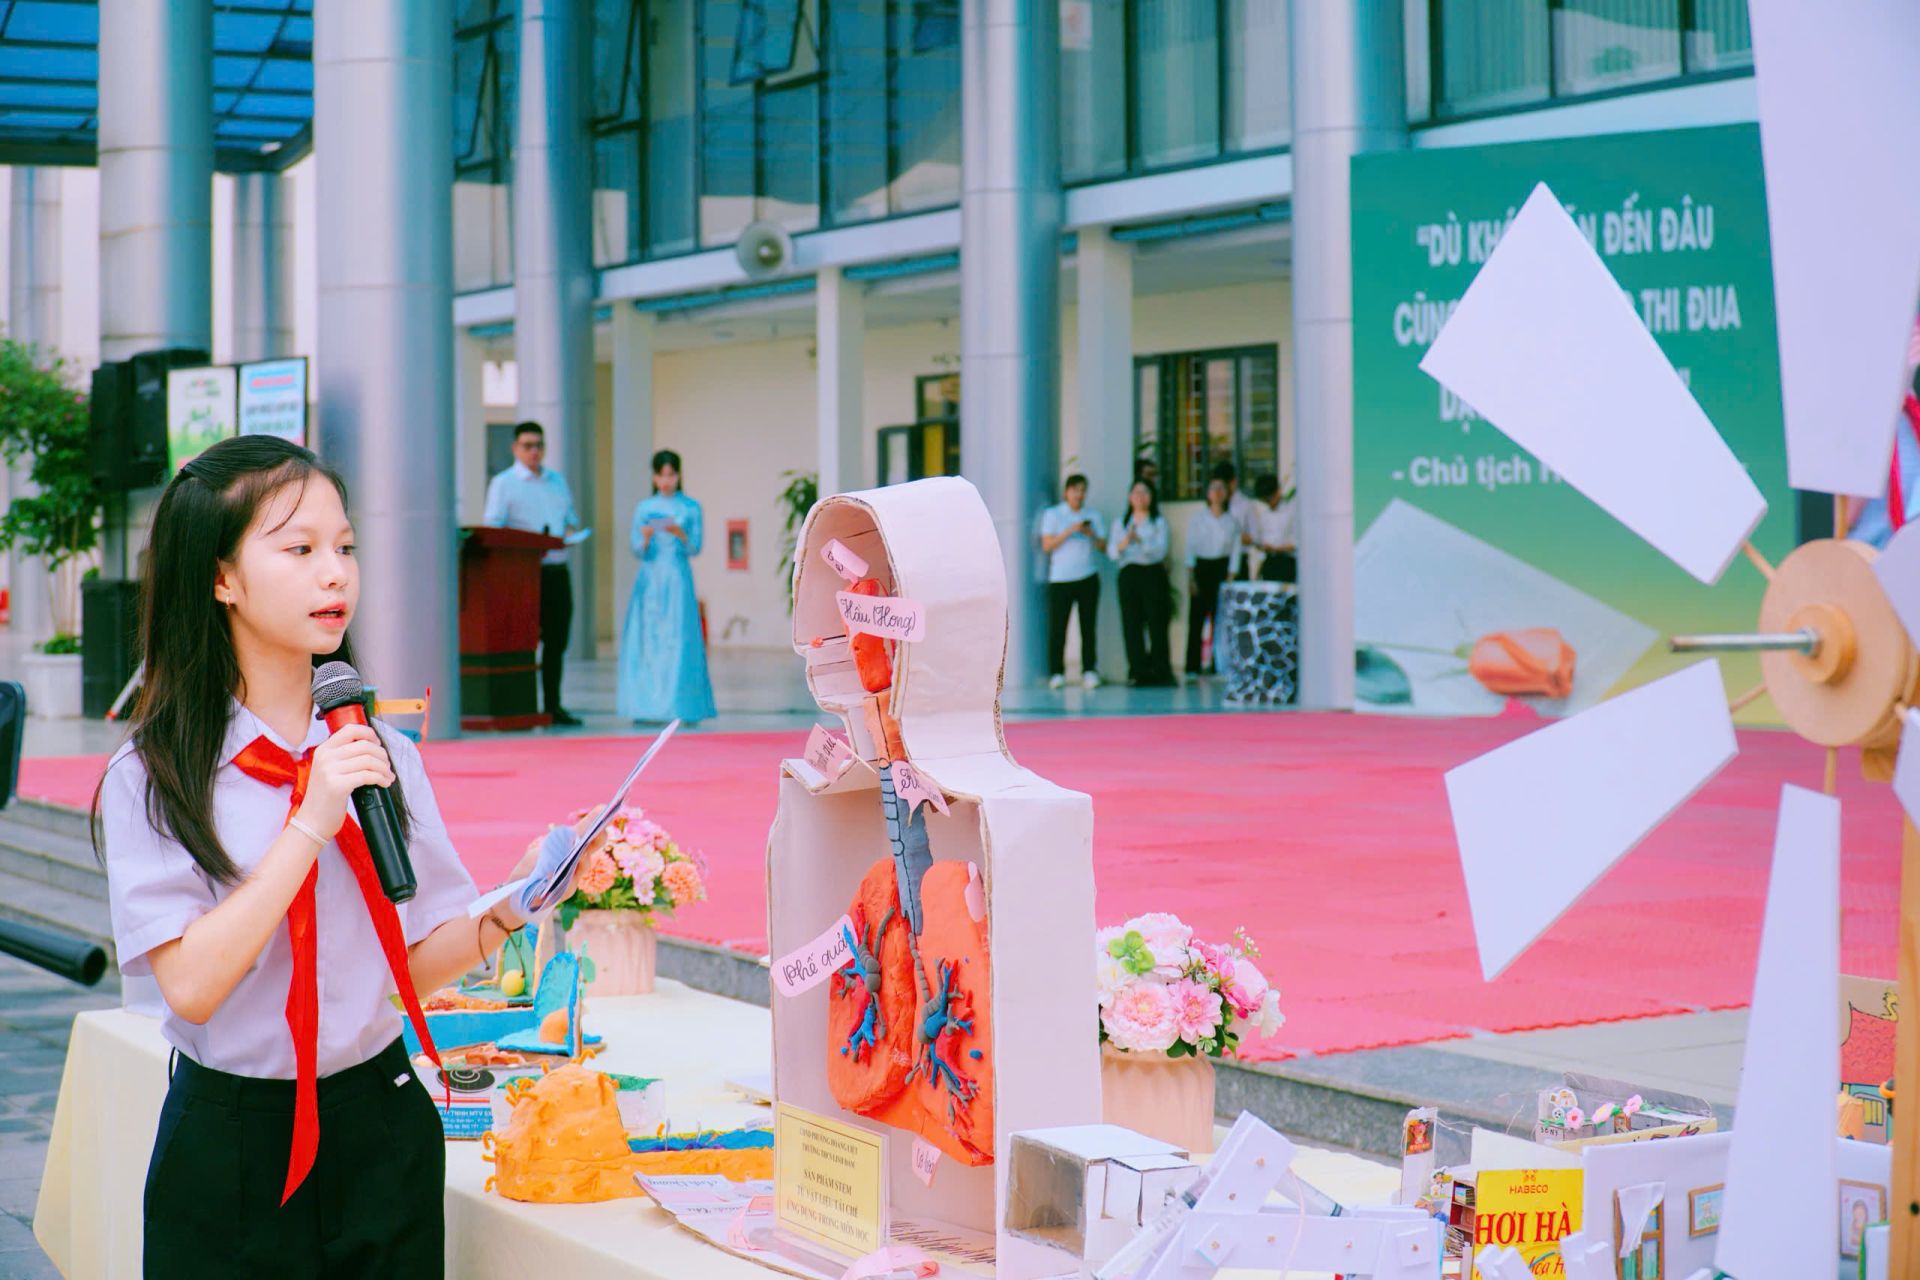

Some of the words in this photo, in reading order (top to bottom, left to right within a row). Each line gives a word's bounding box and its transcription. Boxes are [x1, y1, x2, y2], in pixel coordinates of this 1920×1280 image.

[1603, 191, 1653, 256] ĐẾN
[1659, 194, 1714, 252] ĐÂU
[1393, 290, 1460, 347] CŨN
[1640, 287, 1680, 333] THI
[1686, 284, 1742, 331] ĐUA
[1409, 453, 1468, 487] Chủ
[1475, 453, 1532, 492] tịch
[1509, 1184, 1549, 1194] HABECO
[1476, 1210, 1527, 1245] HƠI
[1534, 1200, 1572, 1242] HÀ
